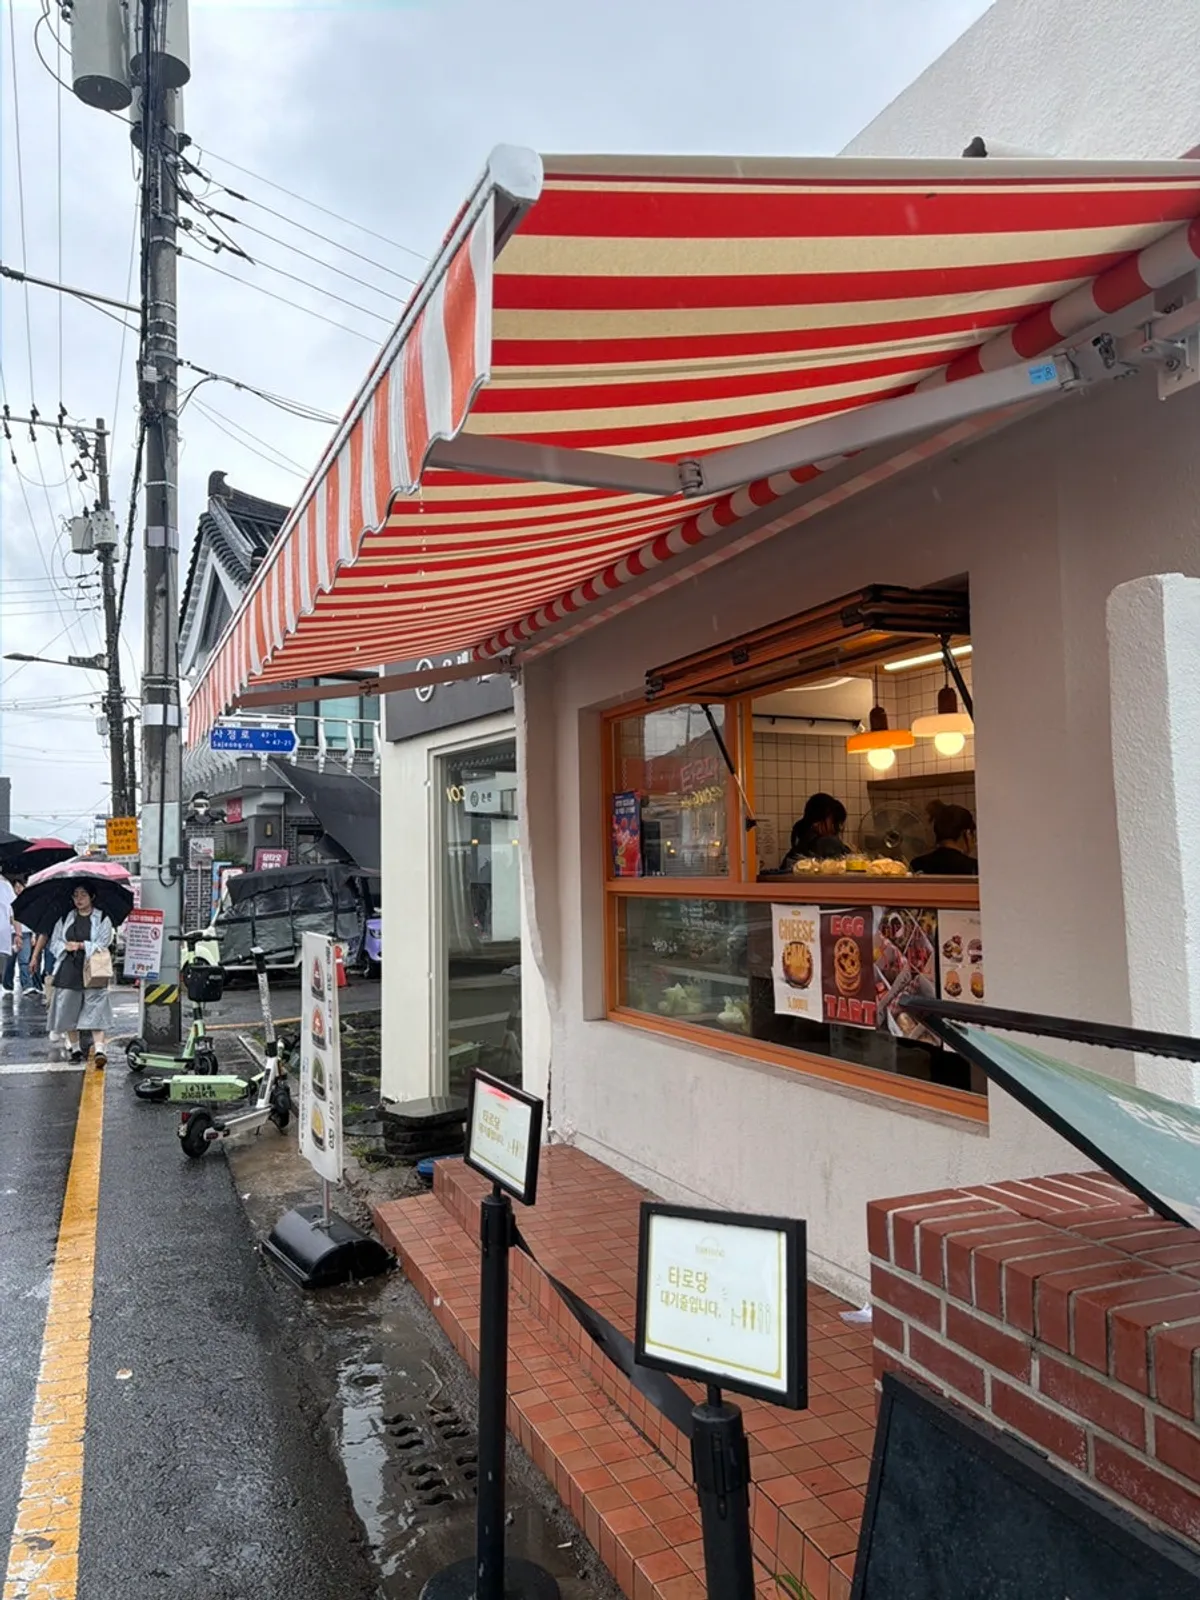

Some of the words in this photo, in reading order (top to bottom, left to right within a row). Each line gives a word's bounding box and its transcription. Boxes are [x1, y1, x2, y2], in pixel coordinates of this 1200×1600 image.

[213, 729, 250, 741] 사정로
[779, 918, 815, 943] CHEESE
[830, 915, 865, 937] EGG
[824, 994, 877, 1025] TART
[668, 1266, 709, 1294] 타로당
[660, 1290, 722, 1319] 대기줄입니다.
